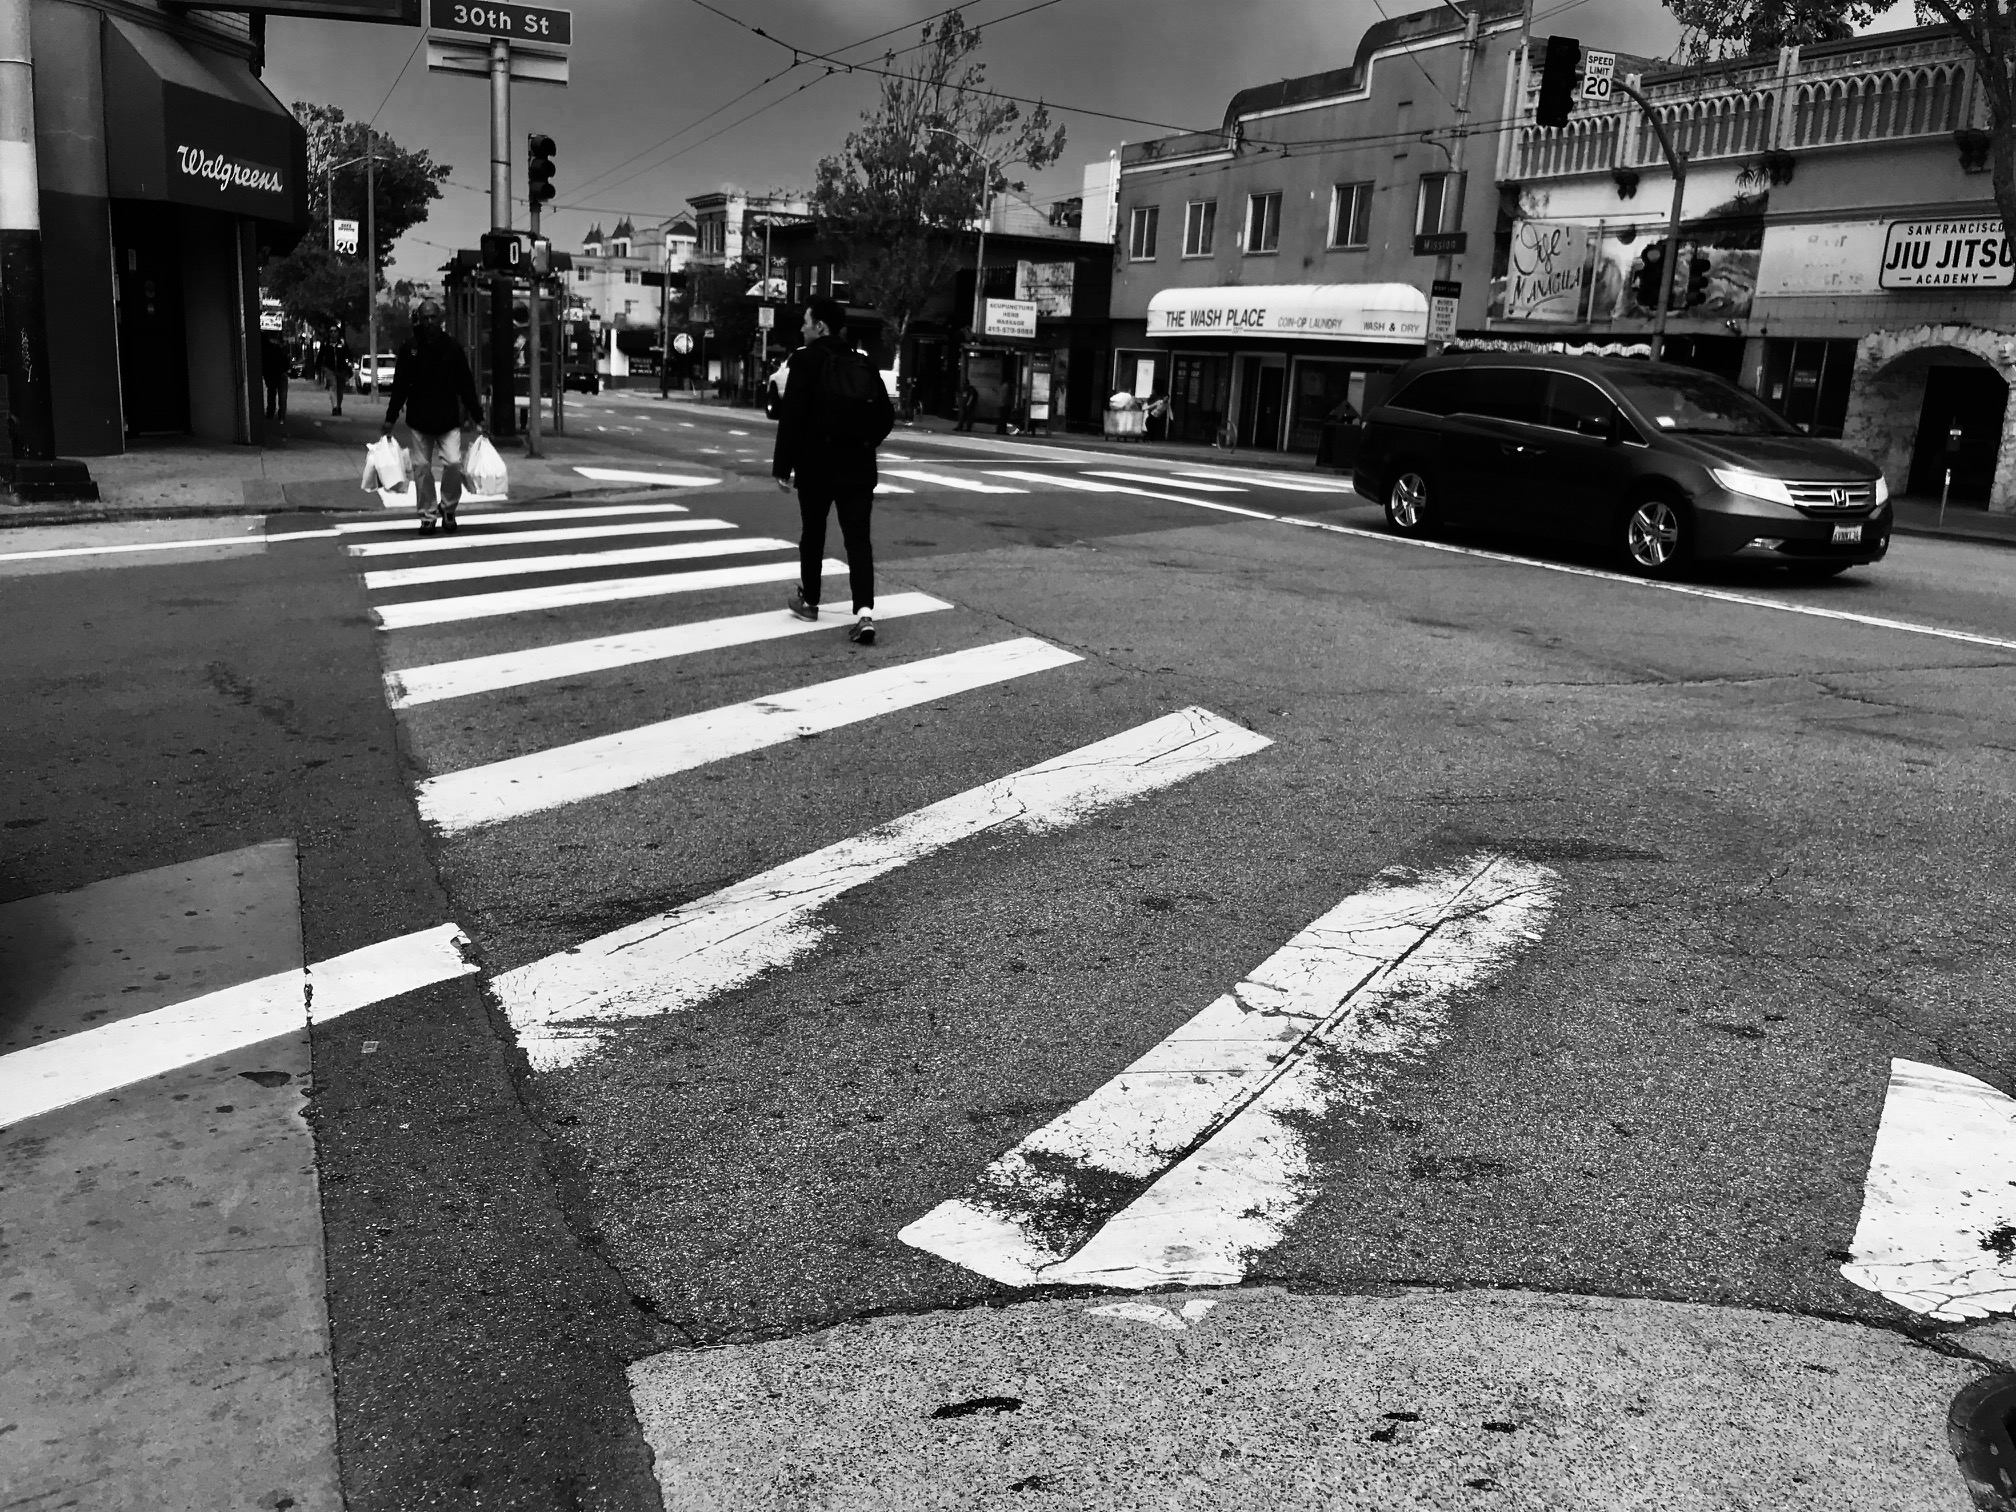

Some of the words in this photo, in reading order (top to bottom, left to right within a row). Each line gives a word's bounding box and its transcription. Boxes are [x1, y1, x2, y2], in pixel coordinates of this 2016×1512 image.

[453, 4, 512, 30] 30th
[524, 14, 550, 35] St
[1587, 54, 1615, 67] SPEED
[1589, 65, 1611, 76] LIMIT
[1584, 76, 1610, 97] 20
[176, 144, 284, 193] Walgreens
[1422, 239, 1457, 251] Mission
[1885, 240, 1932, 270] JIU
[1935, 238, 2014, 270] JITSU
[1916, 273, 1979, 285] ACADEMY
[989, 303, 1034, 311] ACUPUNCTURE
[1165, 310, 1186, 327] THE
[1190, 308, 1223, 327] WASH
[1225, 308, 1267, 328] PLACE
[1277, 316, 1307, 328] COIN-OP
[1308, 317, 1343, 329] LAUNDRY
[1362, 321, 1386, 331] WASH
[1388, 322, 1396, 332] &
[1400, 322, 1420, 333] DRY
